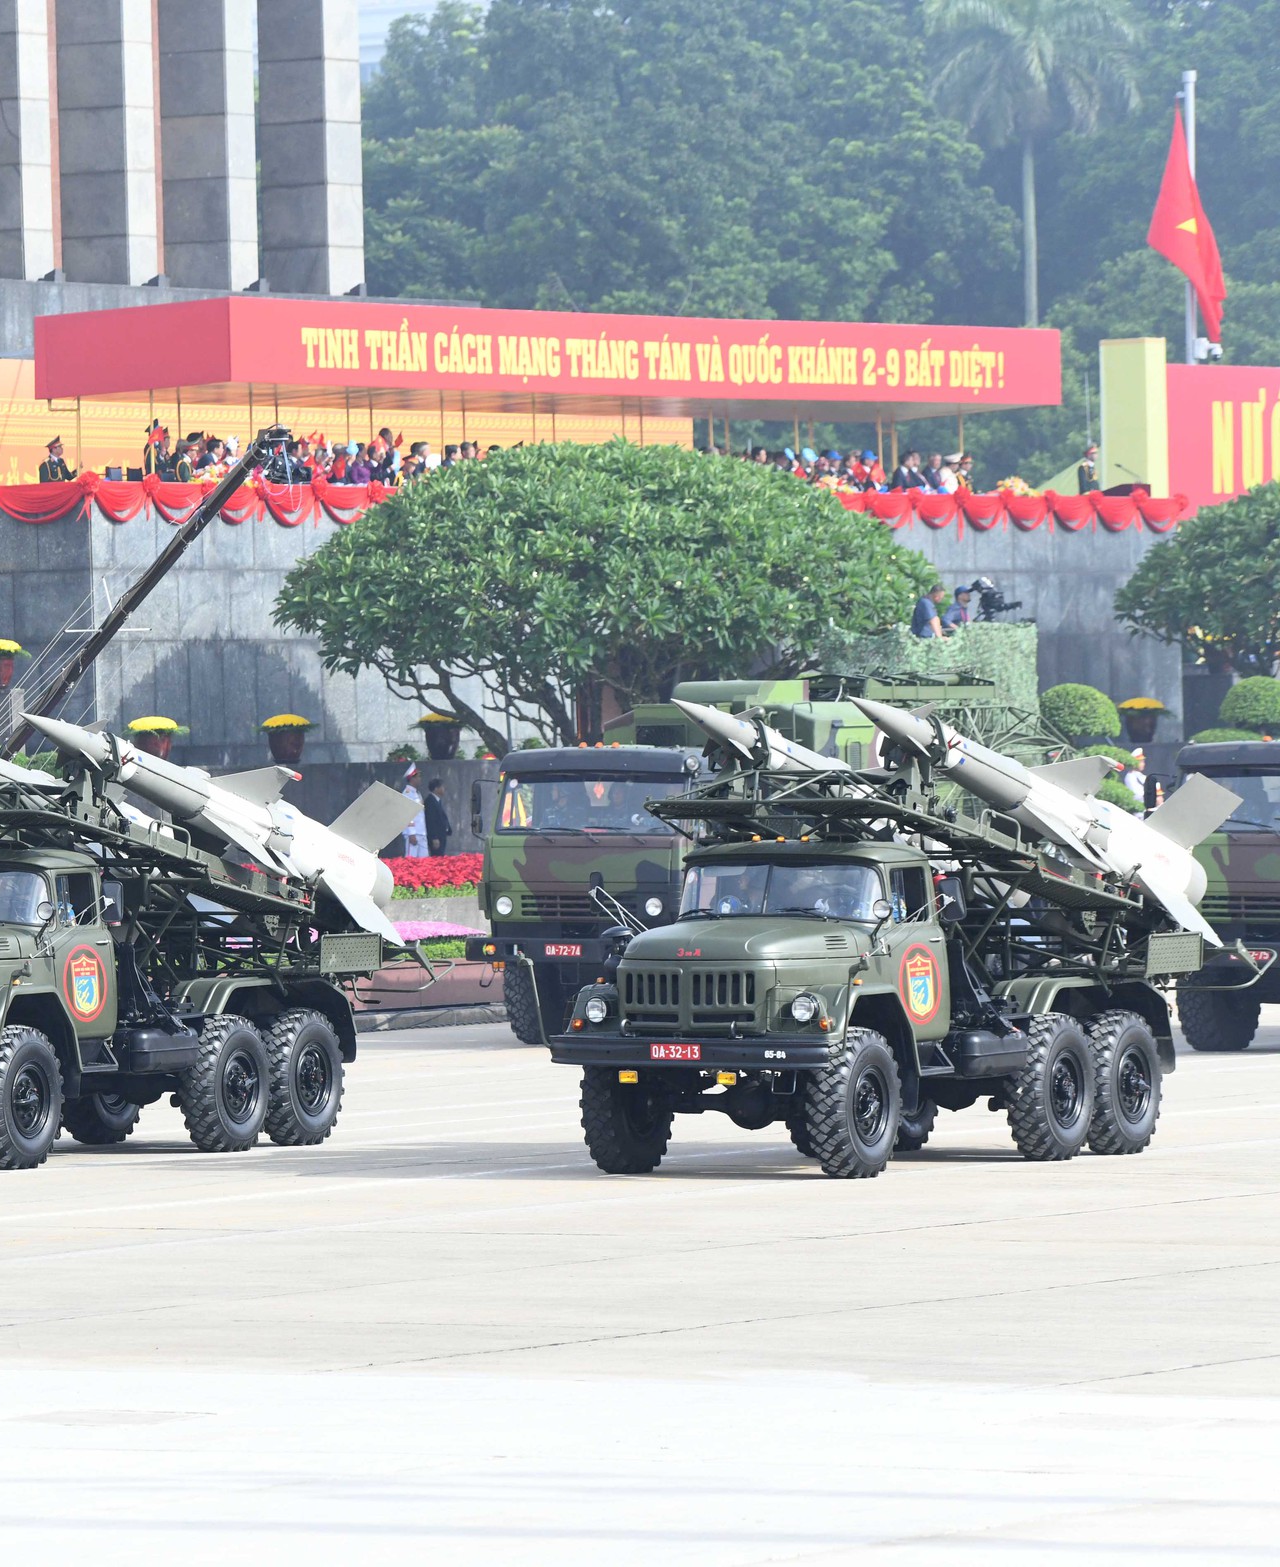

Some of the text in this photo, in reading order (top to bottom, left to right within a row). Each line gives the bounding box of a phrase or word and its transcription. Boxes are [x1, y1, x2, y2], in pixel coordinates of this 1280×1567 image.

[301, 318, 1005, 395] TINH THẦN CÁCH MẠNG THÁNG TÁM VÀ QUỐC KHÁNH 2-9 BẤT DIỆT!
[652, 1045, 699, 1059] QA-32-13
